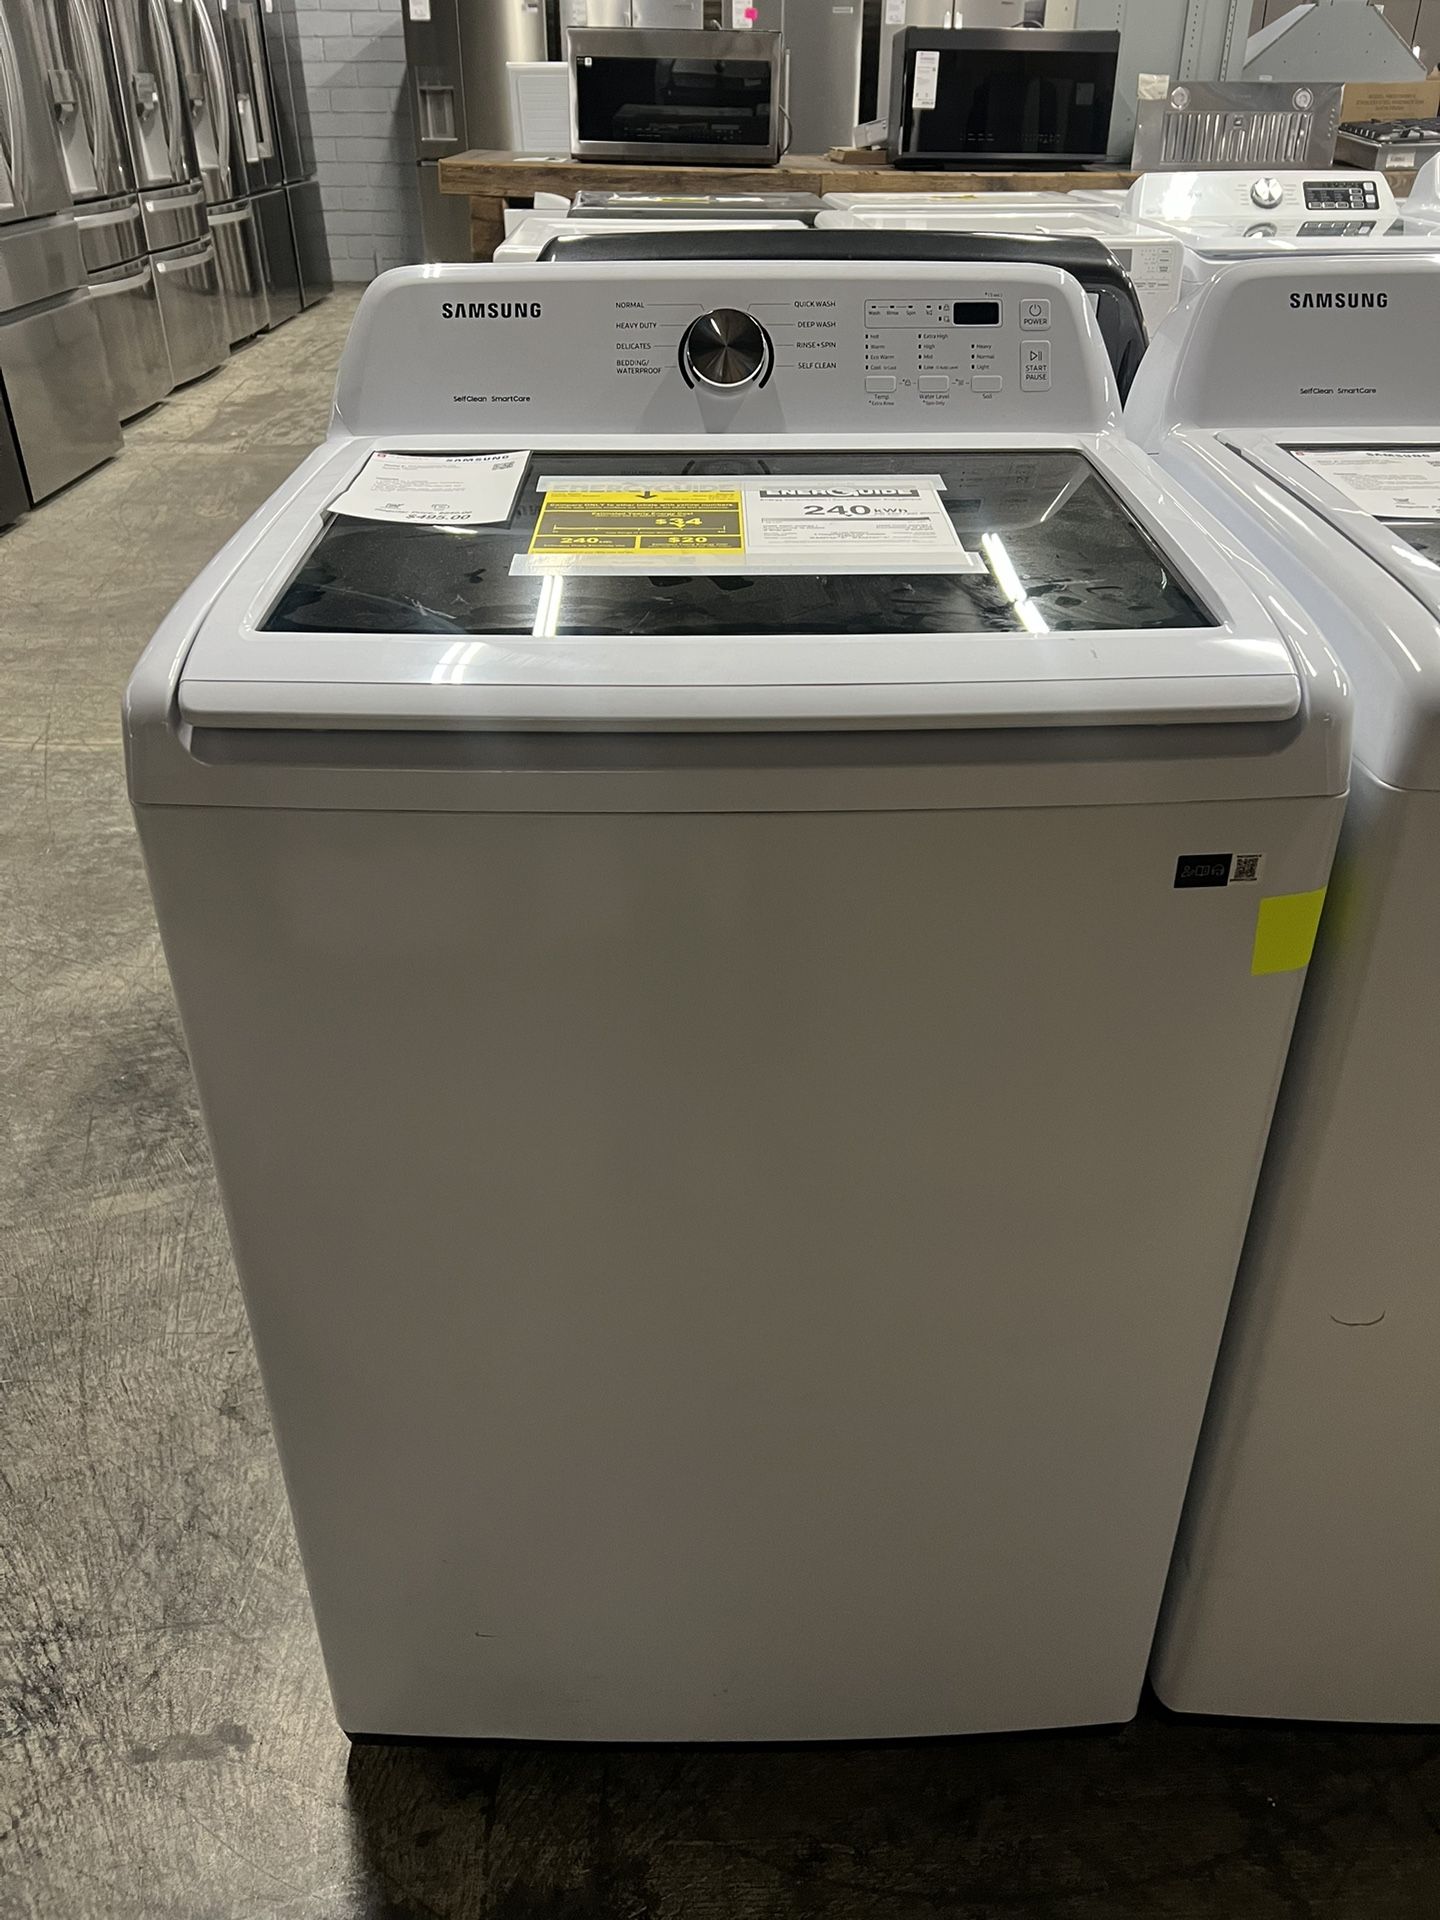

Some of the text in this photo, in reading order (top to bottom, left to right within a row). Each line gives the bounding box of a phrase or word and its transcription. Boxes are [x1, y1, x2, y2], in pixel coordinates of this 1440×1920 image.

[794, 300, 836, 308] QUICK WASH
[1289, 293, 1388, 308] SAMSUNG
[442, 303, 541, 318] SAMSUNG
[616, 359, 650, 367] BEDDING/
[1300, 387, 1334, 395] SelfClean
[804, 505, 870, 515] 240
[655, 517, 703, 526] $34
